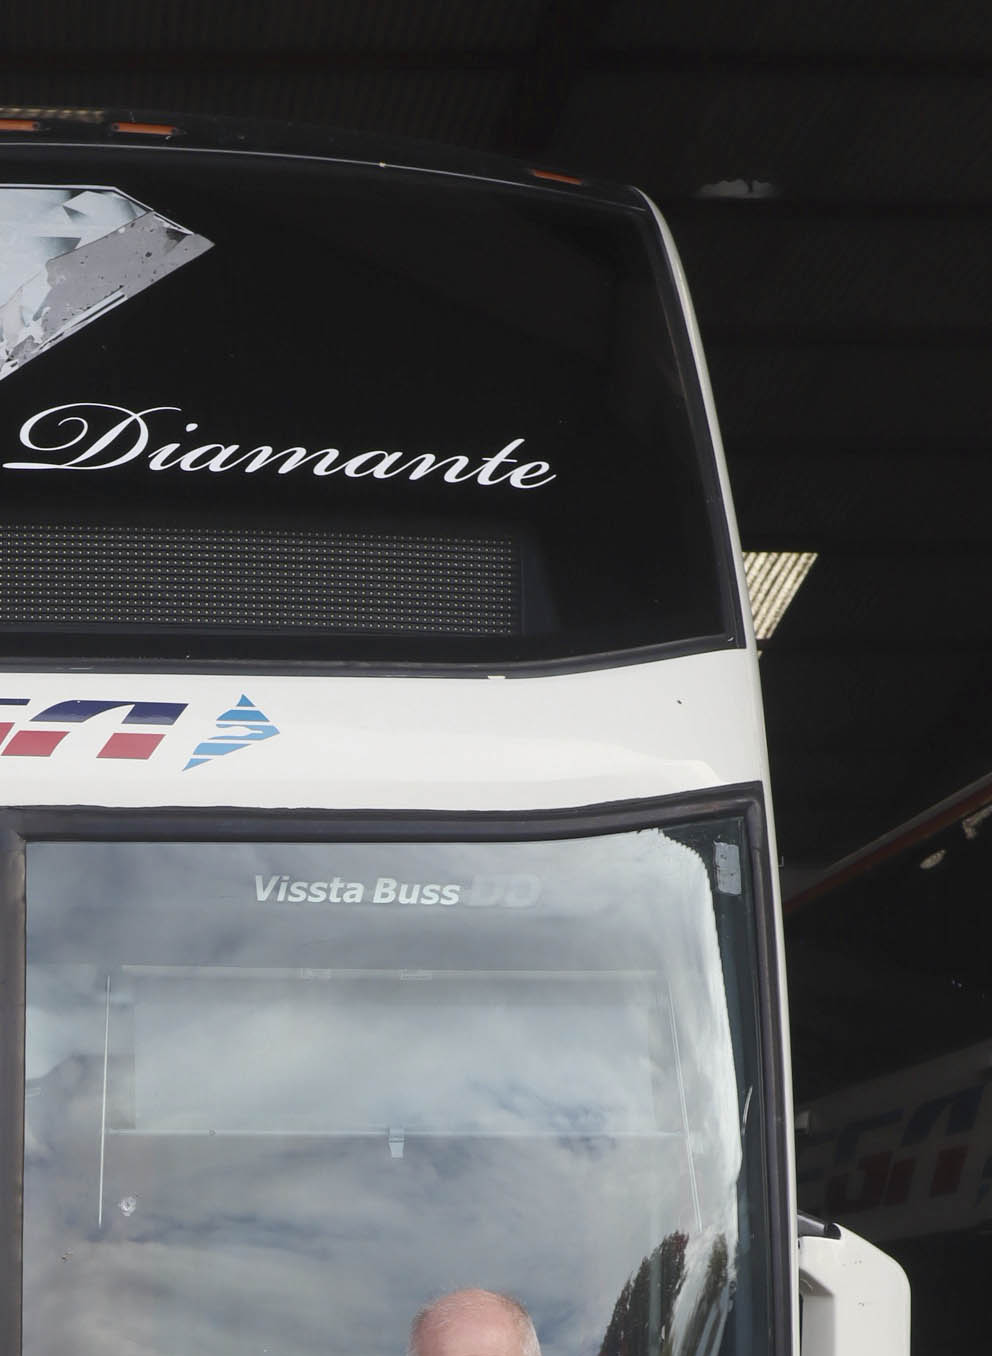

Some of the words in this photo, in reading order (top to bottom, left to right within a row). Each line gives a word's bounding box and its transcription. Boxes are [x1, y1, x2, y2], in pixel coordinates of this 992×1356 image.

[1, 402, 557, 489] Diamante
[255, 873, 365, 904] Vissta
[372, 877, 461, 906] Buss
